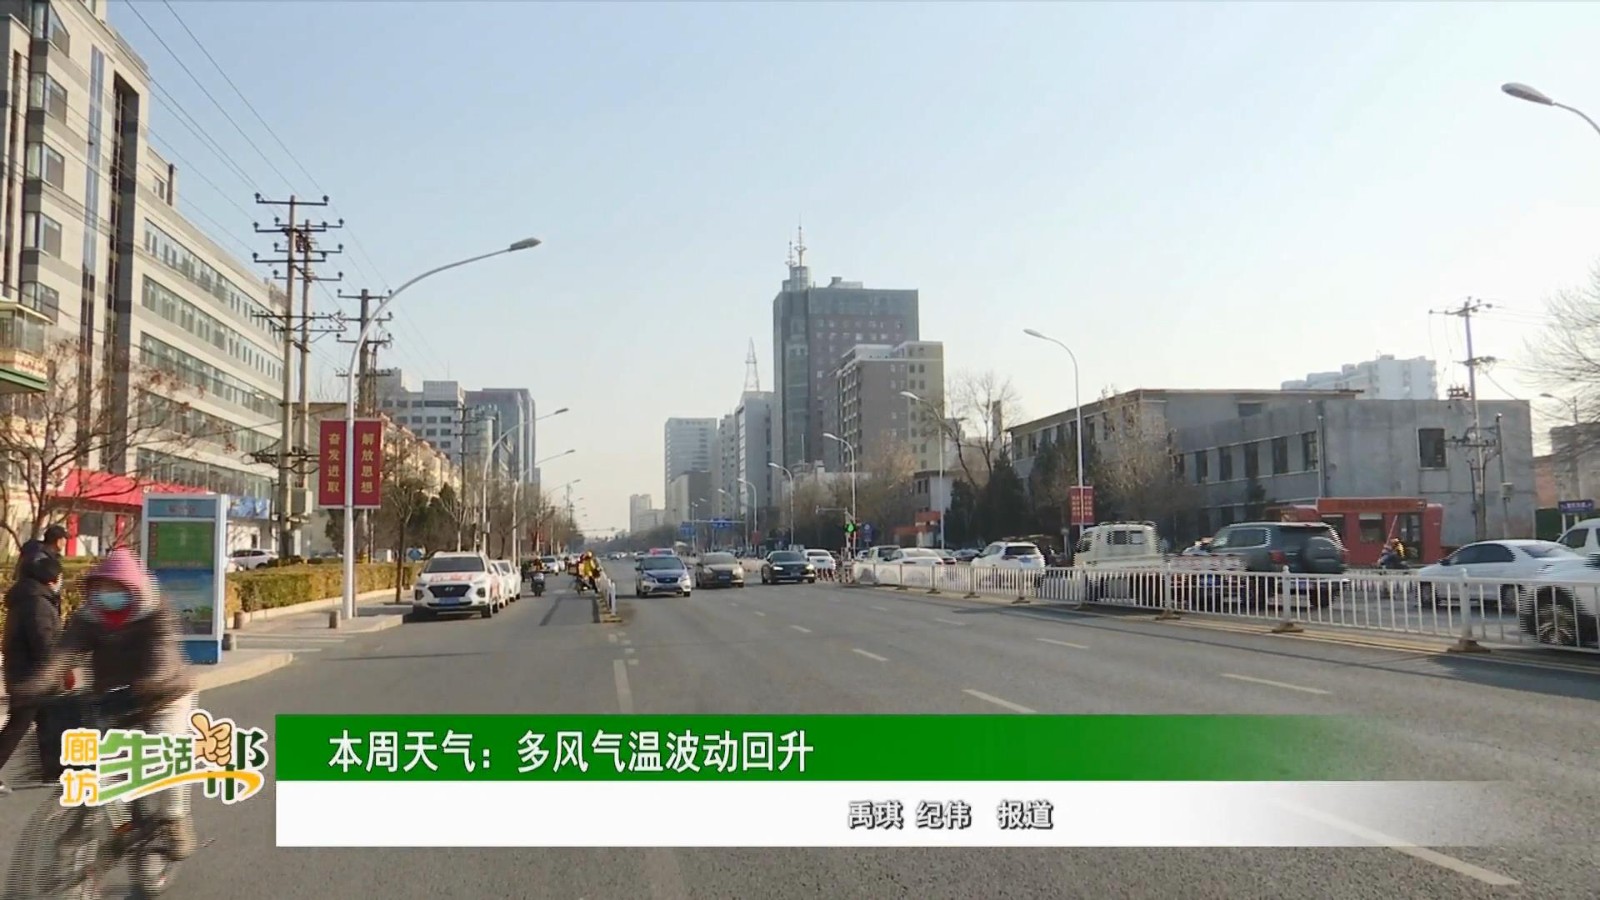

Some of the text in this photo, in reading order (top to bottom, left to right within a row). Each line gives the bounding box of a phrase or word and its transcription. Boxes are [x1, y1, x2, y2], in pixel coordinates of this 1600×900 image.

[328, 432, 341, 494] 奋发进取
[361, 432, 375, 495] 解放思想
